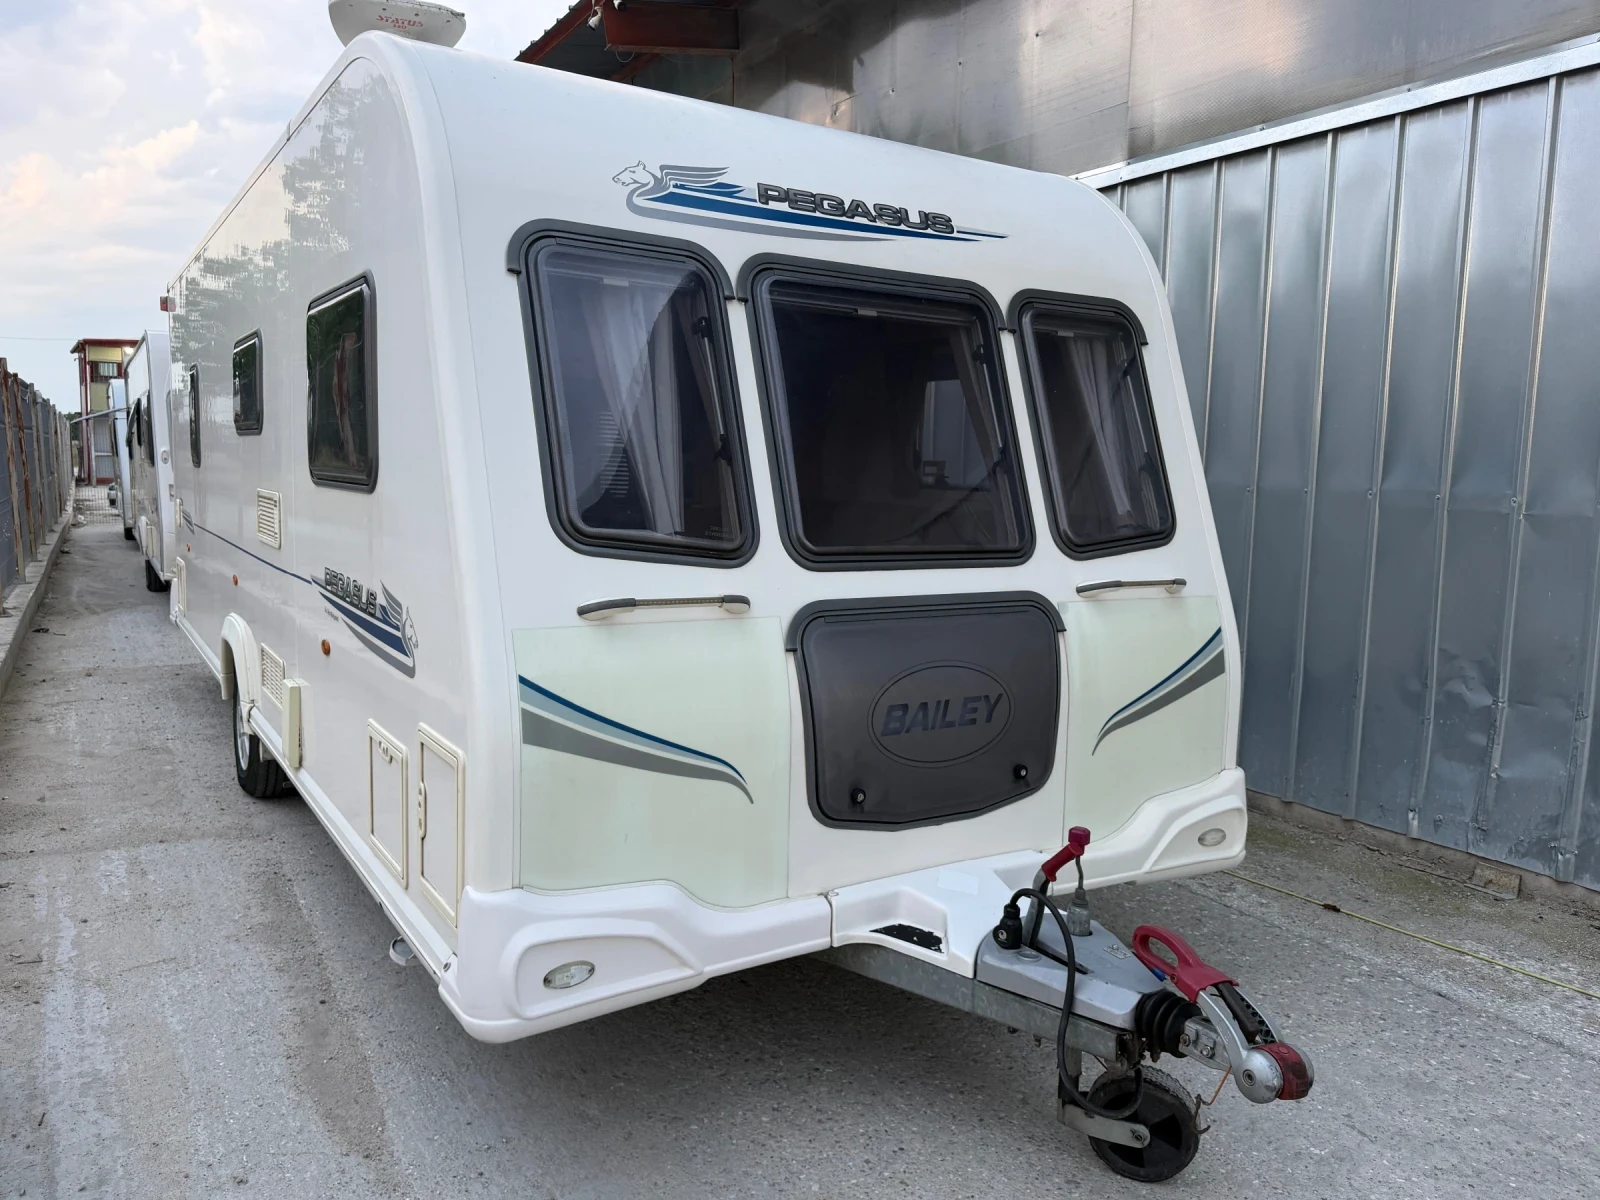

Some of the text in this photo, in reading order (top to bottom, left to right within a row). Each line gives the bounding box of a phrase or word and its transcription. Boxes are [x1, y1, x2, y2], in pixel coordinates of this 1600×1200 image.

[376, 14, 424, 28] STATUS
[757, 182, 956, 235] PEGASUS
[324, 566, 378, 617] PEGASUS
[880, 692, 1004, 737] BAILEY
